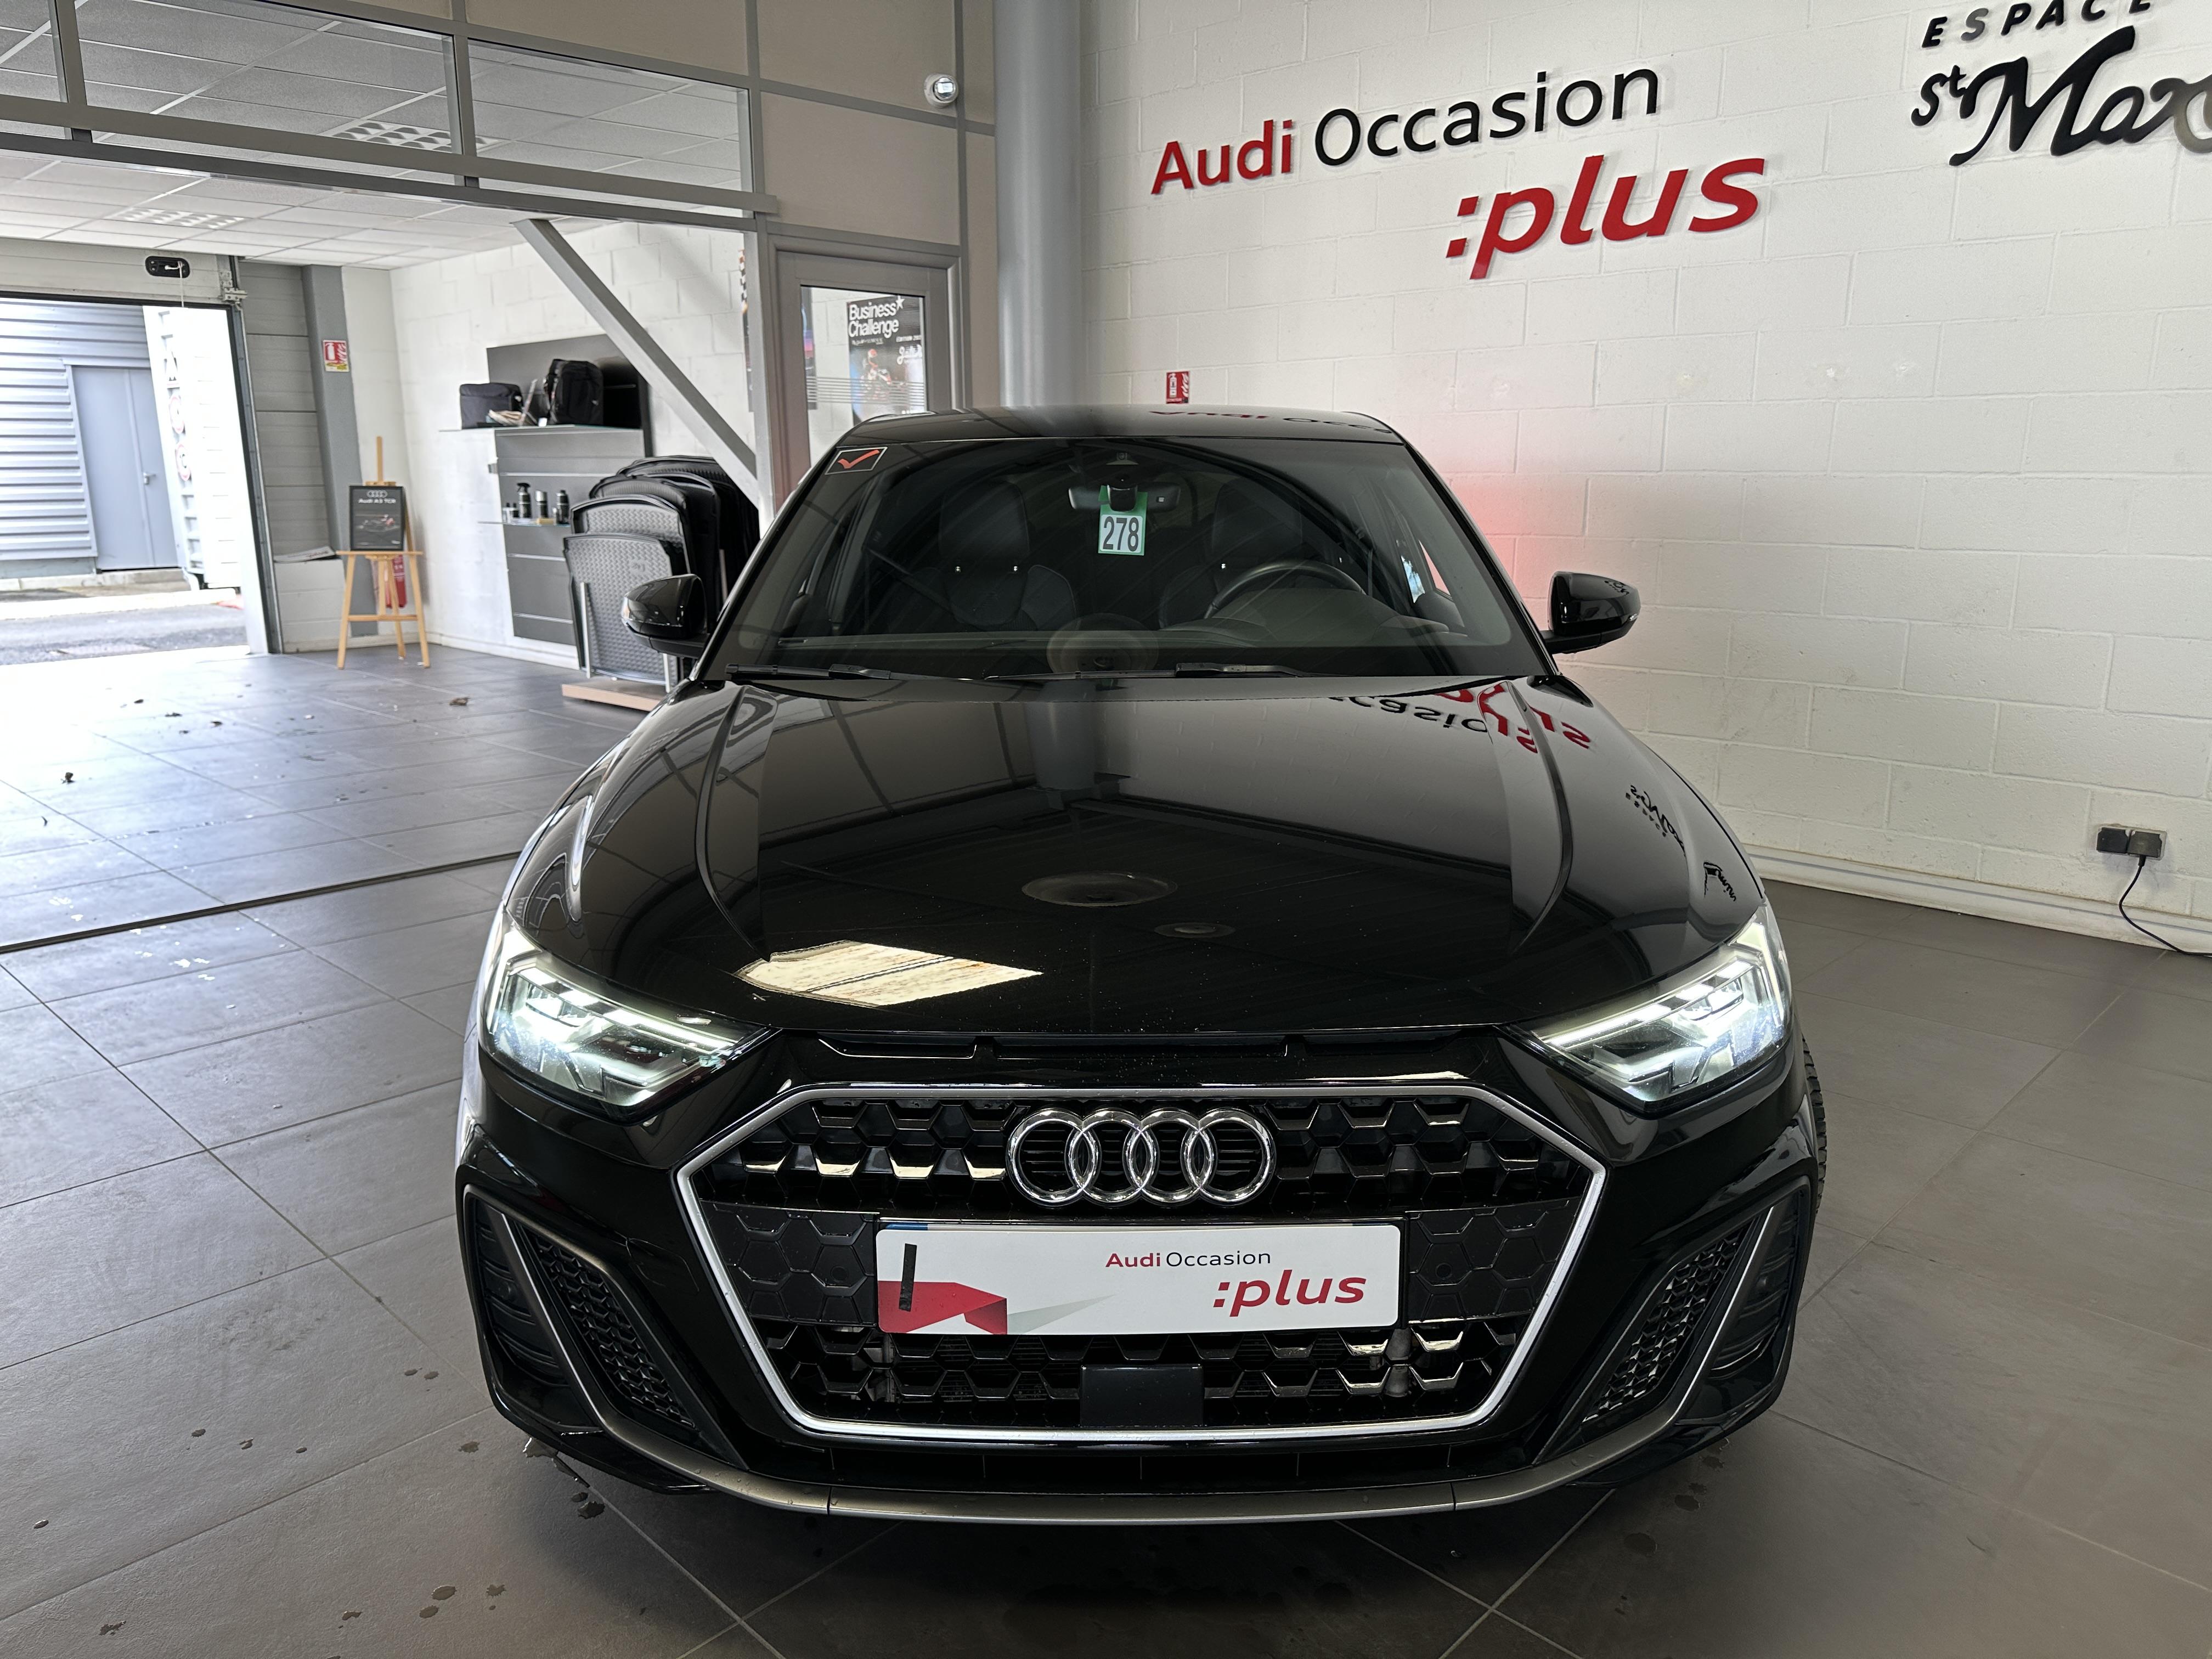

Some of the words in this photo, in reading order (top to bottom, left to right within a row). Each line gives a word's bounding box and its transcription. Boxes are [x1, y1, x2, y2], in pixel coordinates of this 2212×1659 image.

[1151, 119, 1293, 194] Audi
[1314, 69, 1659, 166] Occasion
[1446, 155, 1765, 280] :plus
[849, 302, 896, 320] Business
[849, 319, 899, 338] Challenge
[1103, 516, 1139, 552] 278
[1105, 1252, 1161, 1268] Audi
[1165, 1250, 1271, 1267] Occasion
[1213, 1269, 1367, 1317] :plus
